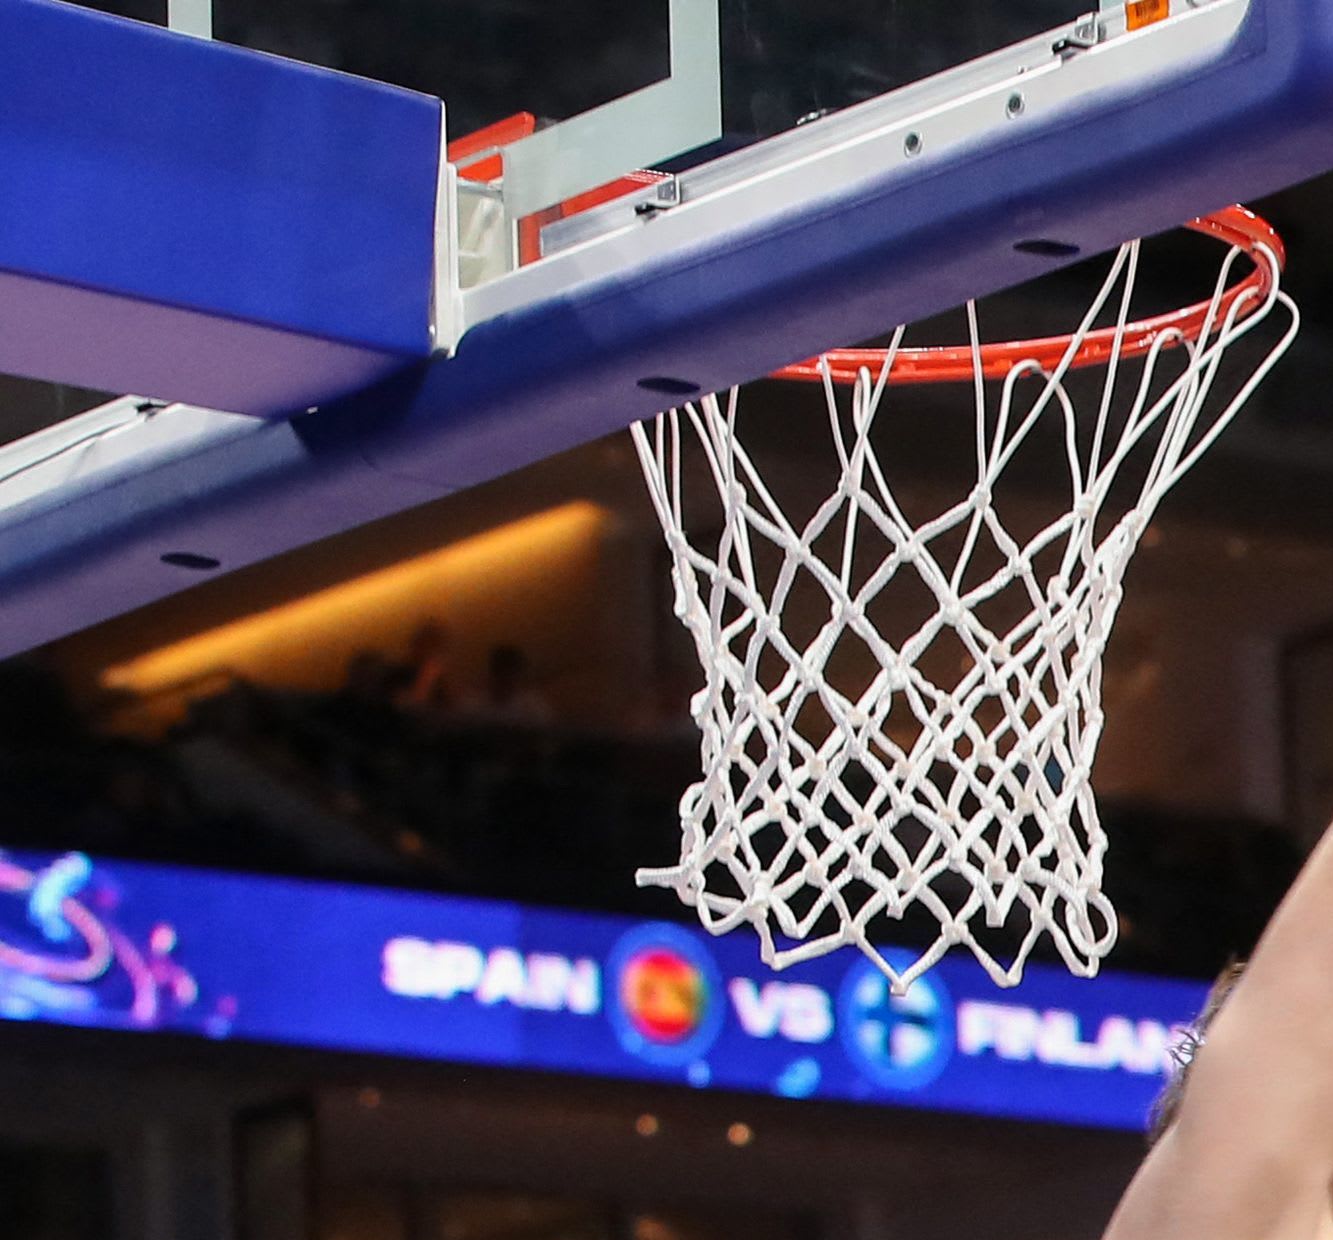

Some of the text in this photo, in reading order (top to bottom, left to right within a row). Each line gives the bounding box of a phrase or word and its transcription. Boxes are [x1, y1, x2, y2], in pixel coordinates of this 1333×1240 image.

[383, 936, 1197, 1074] SPAIN VS FINLAN
